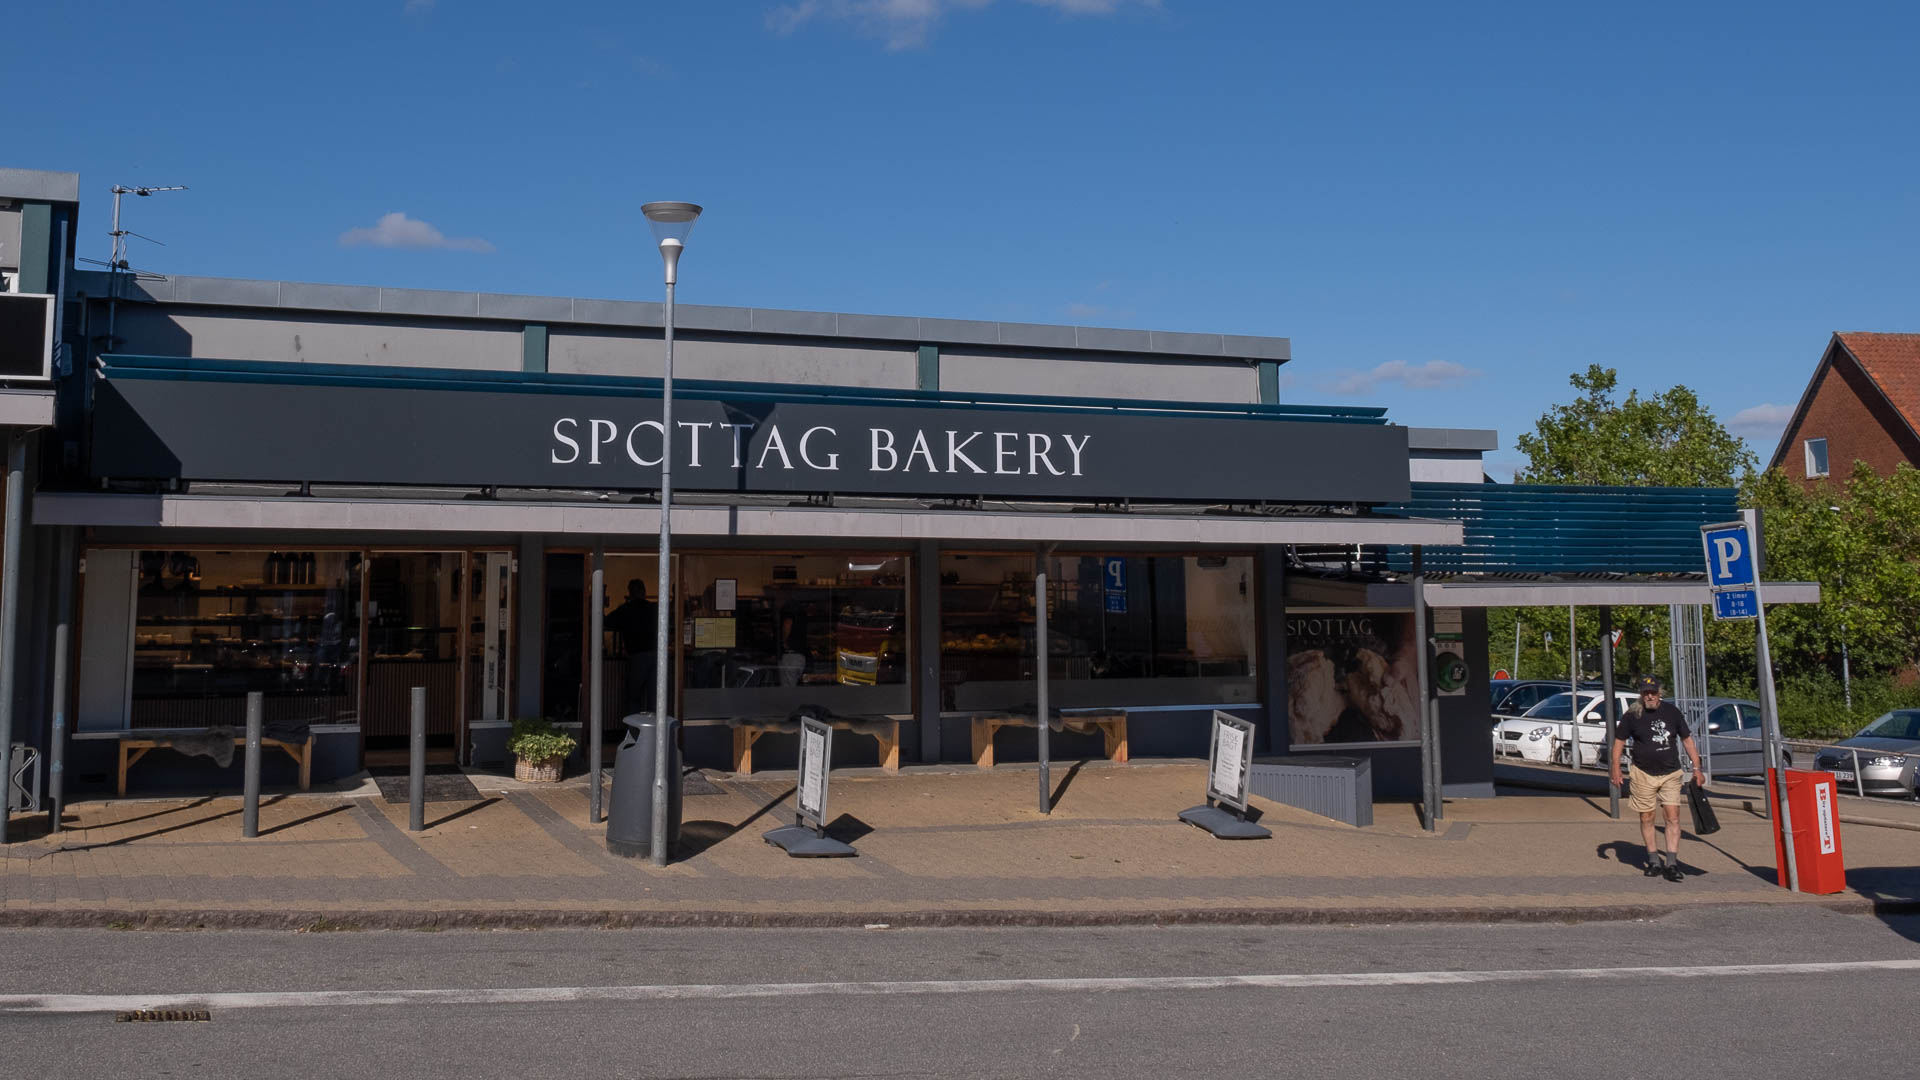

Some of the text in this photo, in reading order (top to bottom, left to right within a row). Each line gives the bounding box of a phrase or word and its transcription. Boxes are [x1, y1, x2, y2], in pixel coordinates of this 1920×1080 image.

[551, 418, 1092, 476] SPOTTAG BAKERY
[1713, 537, 1742, 579] P
[1287, 619, 1372, 636] SPOTTAG
